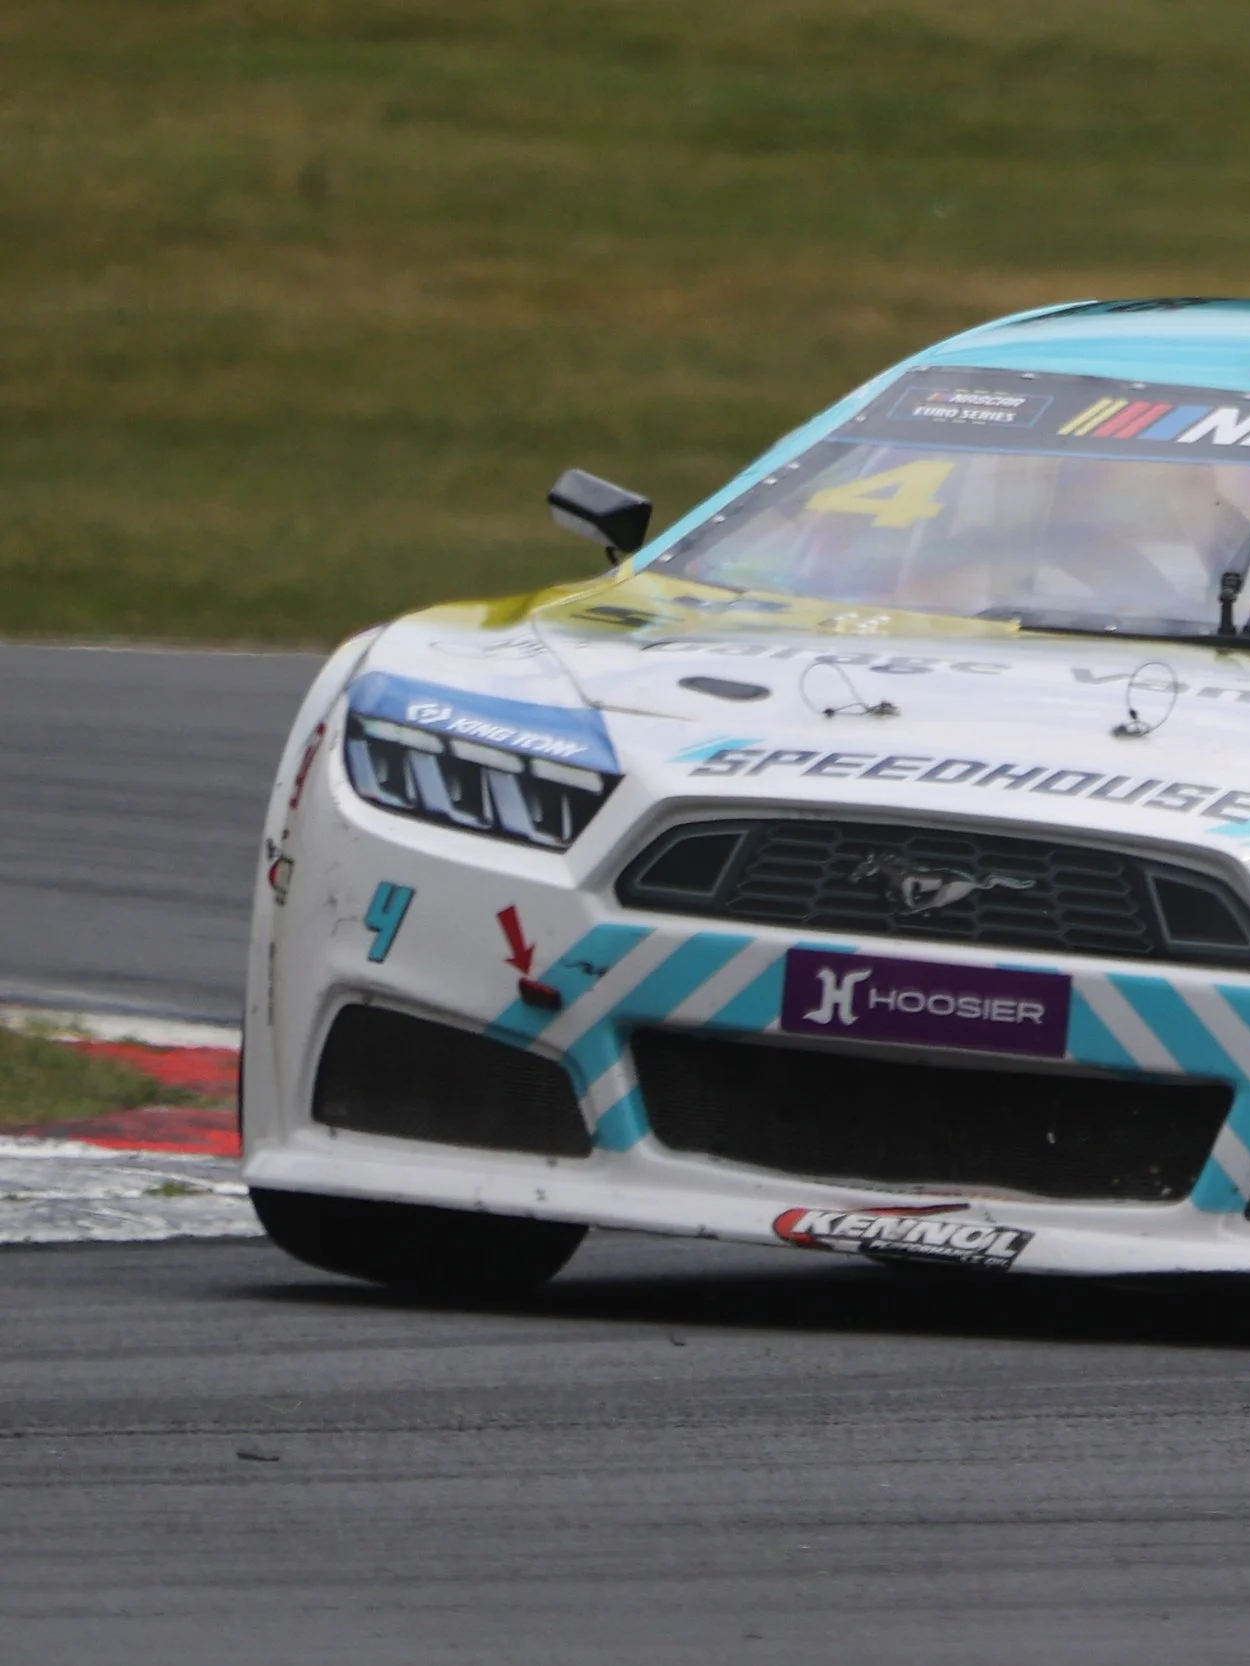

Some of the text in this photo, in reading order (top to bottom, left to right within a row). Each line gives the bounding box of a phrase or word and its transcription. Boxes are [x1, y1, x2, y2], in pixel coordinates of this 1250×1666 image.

[912, 406, 1017, 422] EURO SERIES
[949, 393, 1027, 407] NASCAR
[805, 460, 956, 529] 4
[446, 717, 518, 743] KING
[364, 880, 416, 964] 4
[868, 987, 1046, 1025] HOOSIER
[790, 1210, 1022, 1258] KENNOL
